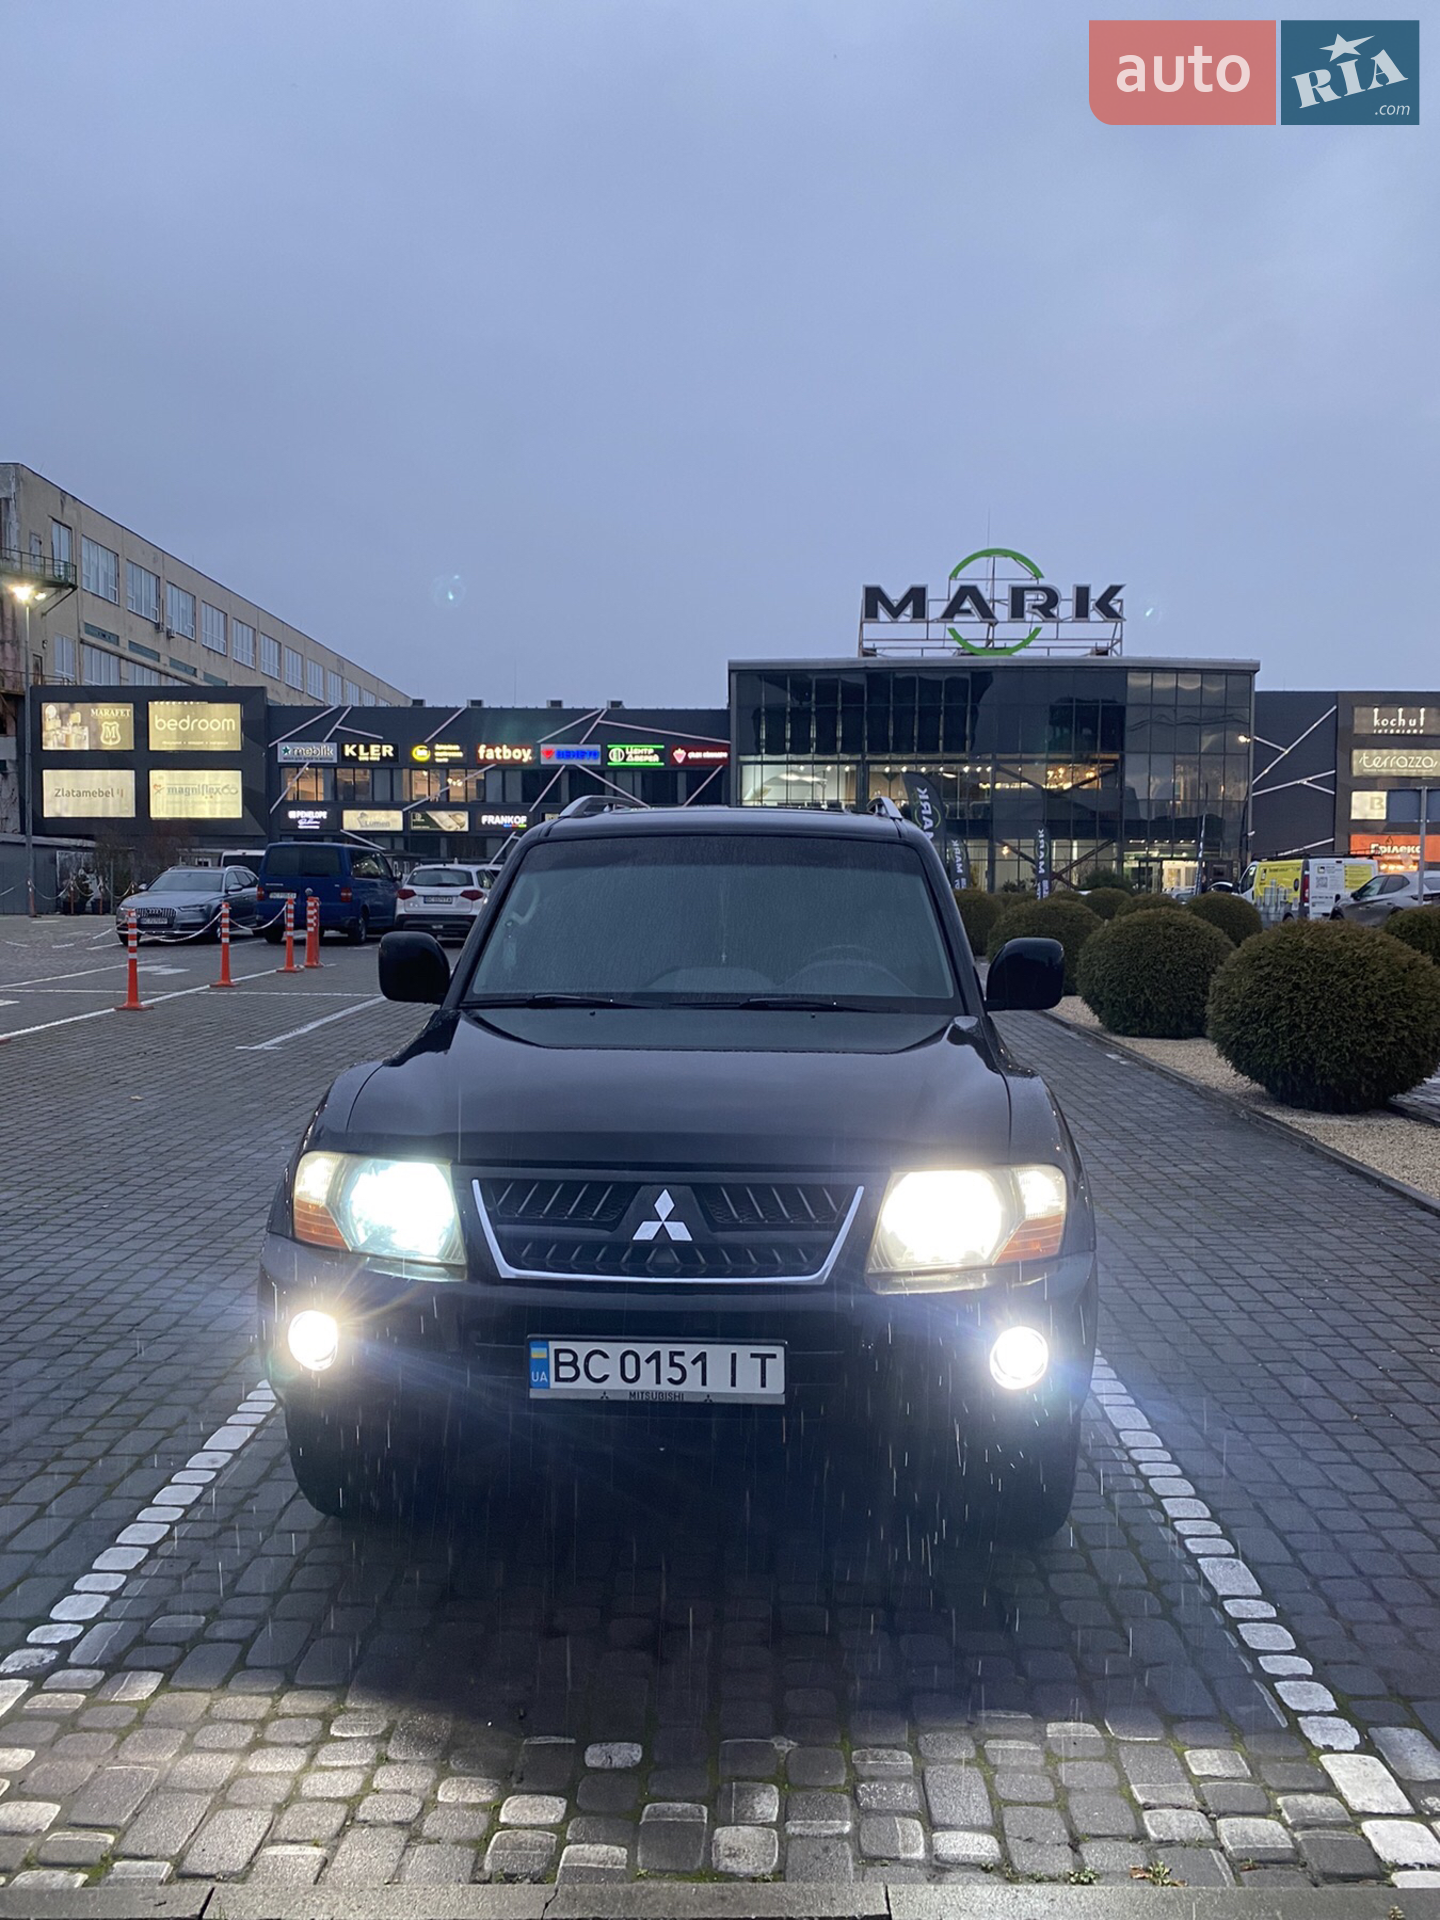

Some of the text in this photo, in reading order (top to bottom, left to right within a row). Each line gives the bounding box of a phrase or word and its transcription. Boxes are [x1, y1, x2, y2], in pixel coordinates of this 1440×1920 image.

[863, 584, 1127, 622] MARK
[91, 708, 131, 717] MARAFET
[155, 714, 236, 731] bedroom
[344, 744, 394, 757] KLER
[1359, 752, 1438, 769] terrazza
[54, 788, 114, 798] Zlatamebel
[553, 1348, 611, 1384] BC
[619, 1349, 708, 1387] 0151
[530, 1371, 548, 1383] UA
[628, 1391, 685, 1402] MITSUBISHI
